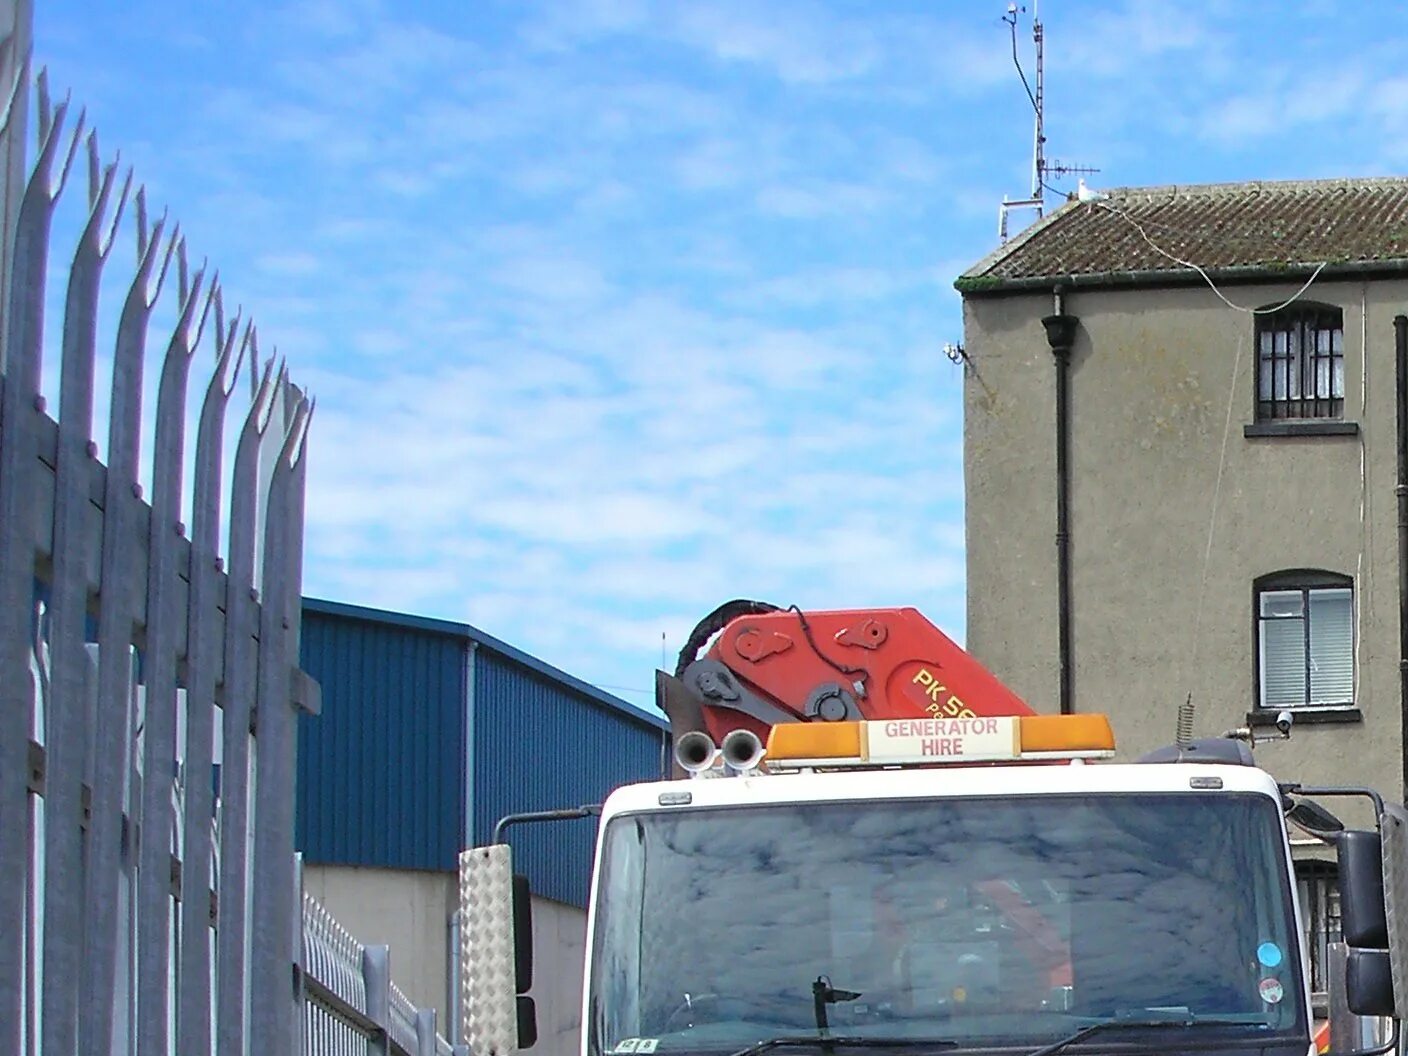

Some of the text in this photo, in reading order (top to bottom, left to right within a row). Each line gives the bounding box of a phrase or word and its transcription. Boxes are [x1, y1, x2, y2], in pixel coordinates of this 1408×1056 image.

[913, 669, 946, 701] PK
[885, 719, 998, 737] GENERATOR
[921, 738, 964, 756] HIRE
